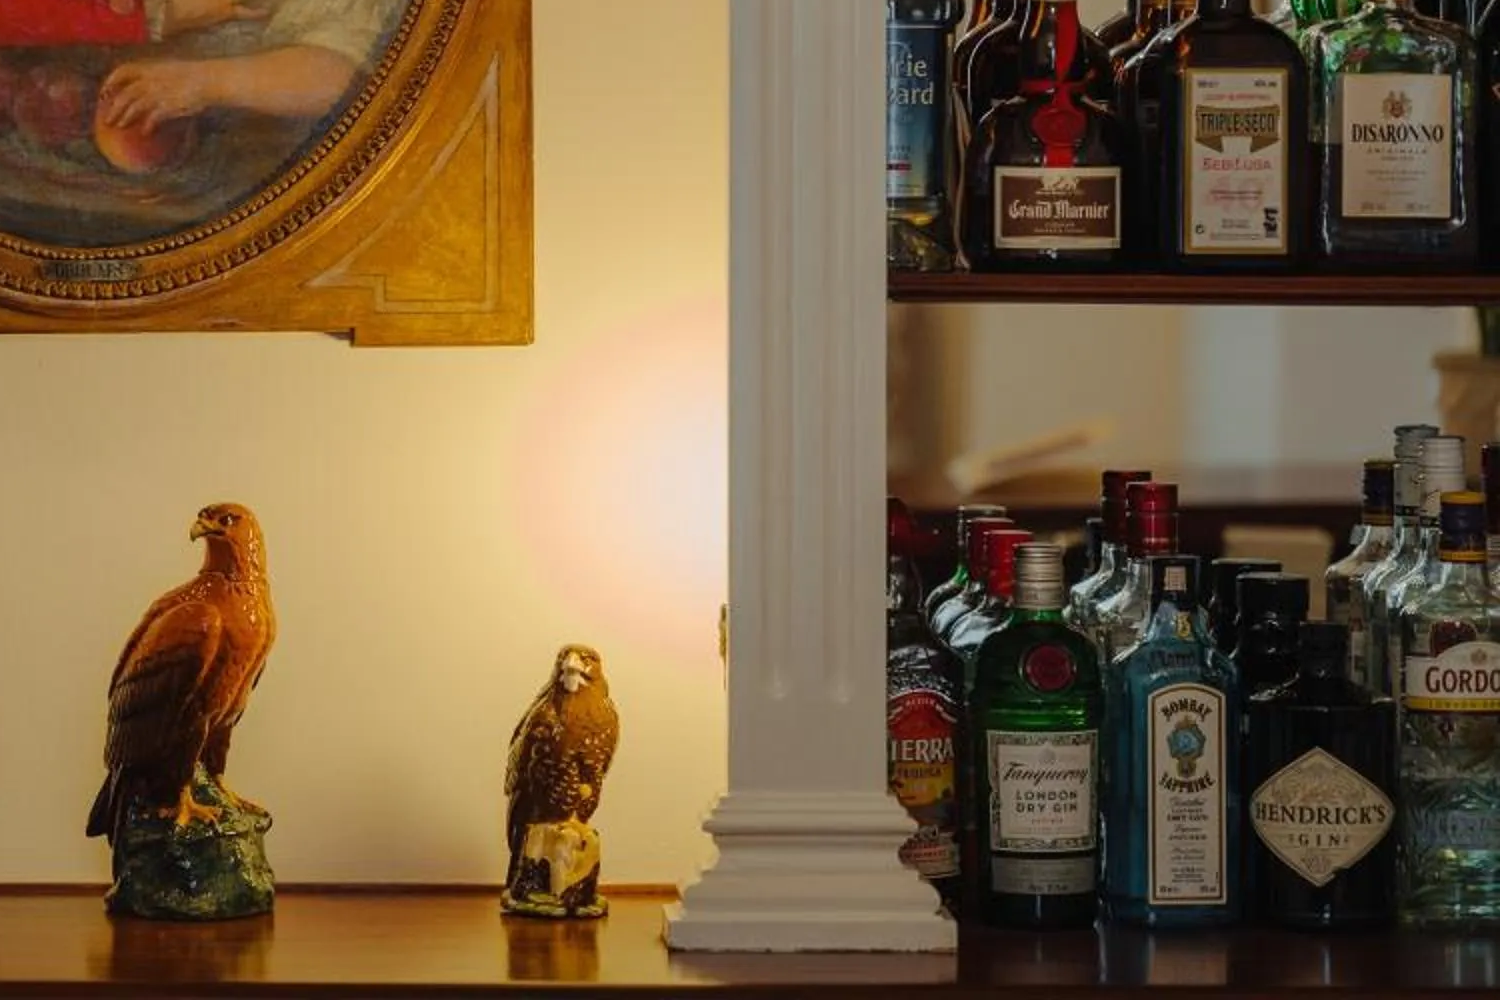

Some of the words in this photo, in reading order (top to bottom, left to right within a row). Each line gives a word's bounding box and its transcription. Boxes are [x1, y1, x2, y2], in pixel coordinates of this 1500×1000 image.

[888, 53, 928, 78] rie
[1351, 123, 1445, 145] DISARONNO
[1008, 199, 1052, 220] Grand
[1053, 199, 1110, 220] Marnier
[1425, 665, 1500, 694] GORDO
[1161, 698, 1213, 722] BOMBAY
[890, 736, 955, 764] IERRA
[1003, 760, 1089, 787] Tanqueray
[1158, 770, 1215, 794] SAPPHIRE
[1015, 789, 1079, 801] LONDON
[1015, 803, 1046, 813] DRY
[1052, 803, 1078, 813] GIN
[1255, 802, 1387, 825] HENDRICK'S
[1298, 833, 1342, 846] GIN
